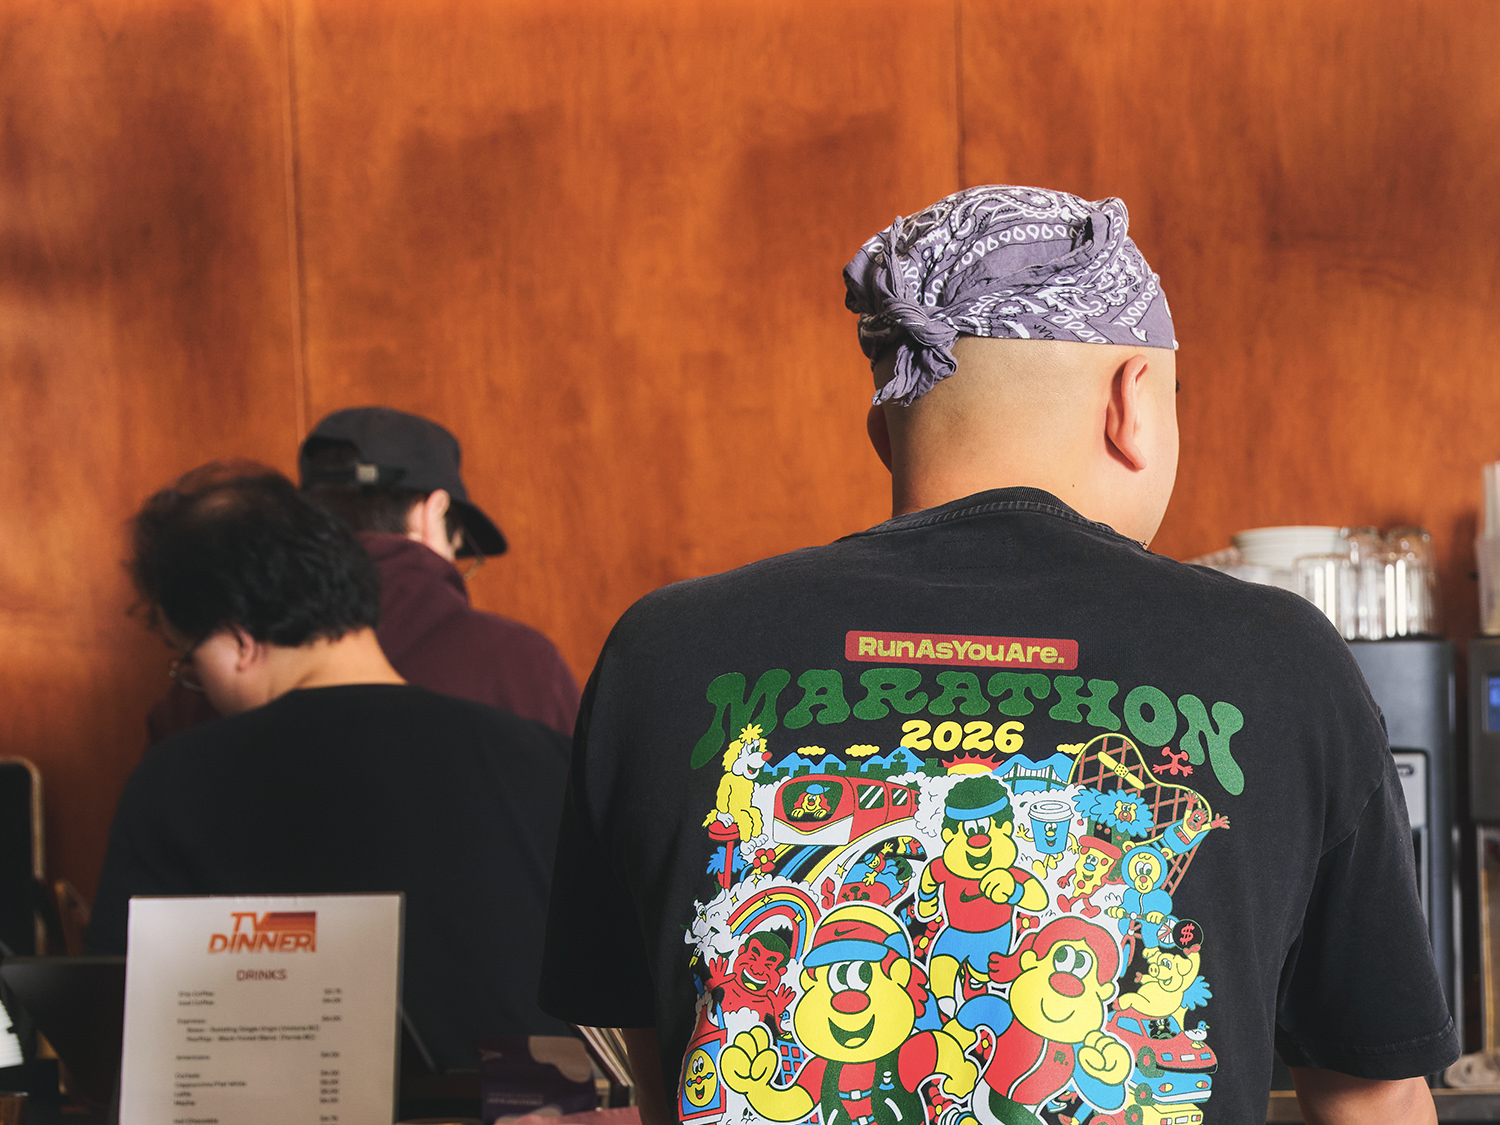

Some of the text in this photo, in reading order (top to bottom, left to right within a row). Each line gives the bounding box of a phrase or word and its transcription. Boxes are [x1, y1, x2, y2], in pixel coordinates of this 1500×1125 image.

[858, 636, 1065, 664] RunAsYouAre.
[690, 667, 1245, 796] MARATHON
[900, 719, 1025, 754] 2026
[229, 910, 282, 933] TV
[207, 932, 315, 954] DINNER
[235, 968, 288, 982] DRINKS
